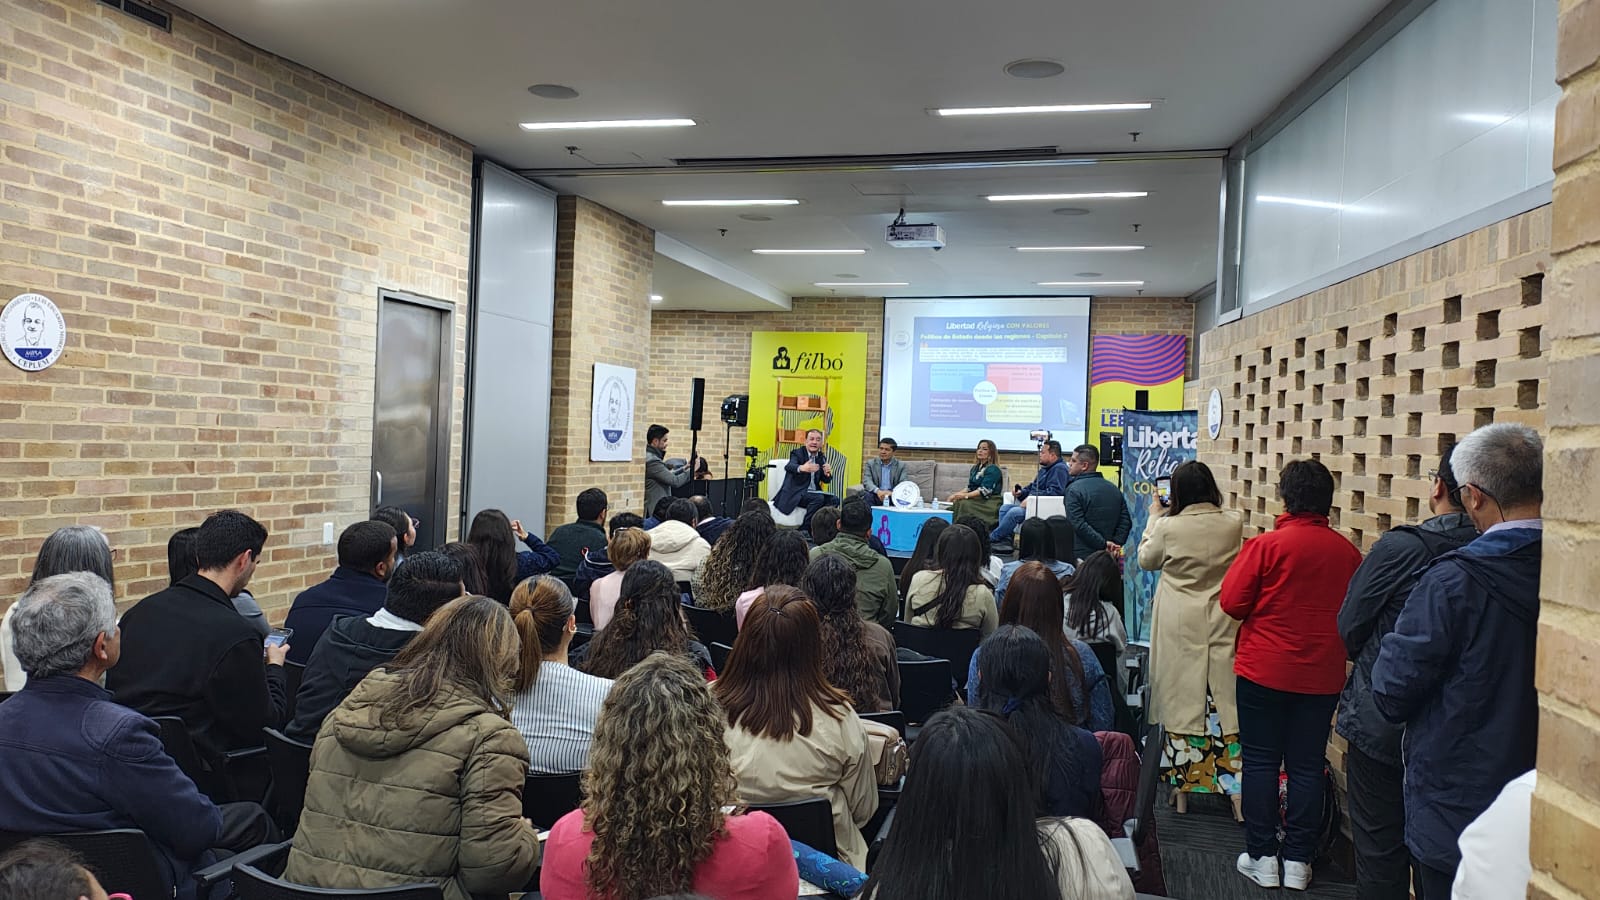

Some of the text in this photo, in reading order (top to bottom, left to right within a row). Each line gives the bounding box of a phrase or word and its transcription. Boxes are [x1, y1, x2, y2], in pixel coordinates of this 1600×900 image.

[945, 321, 975, 330] Libertad
[18, 358, 50, 369] CEPLEM
[790, 352, 843, 373] filbo
